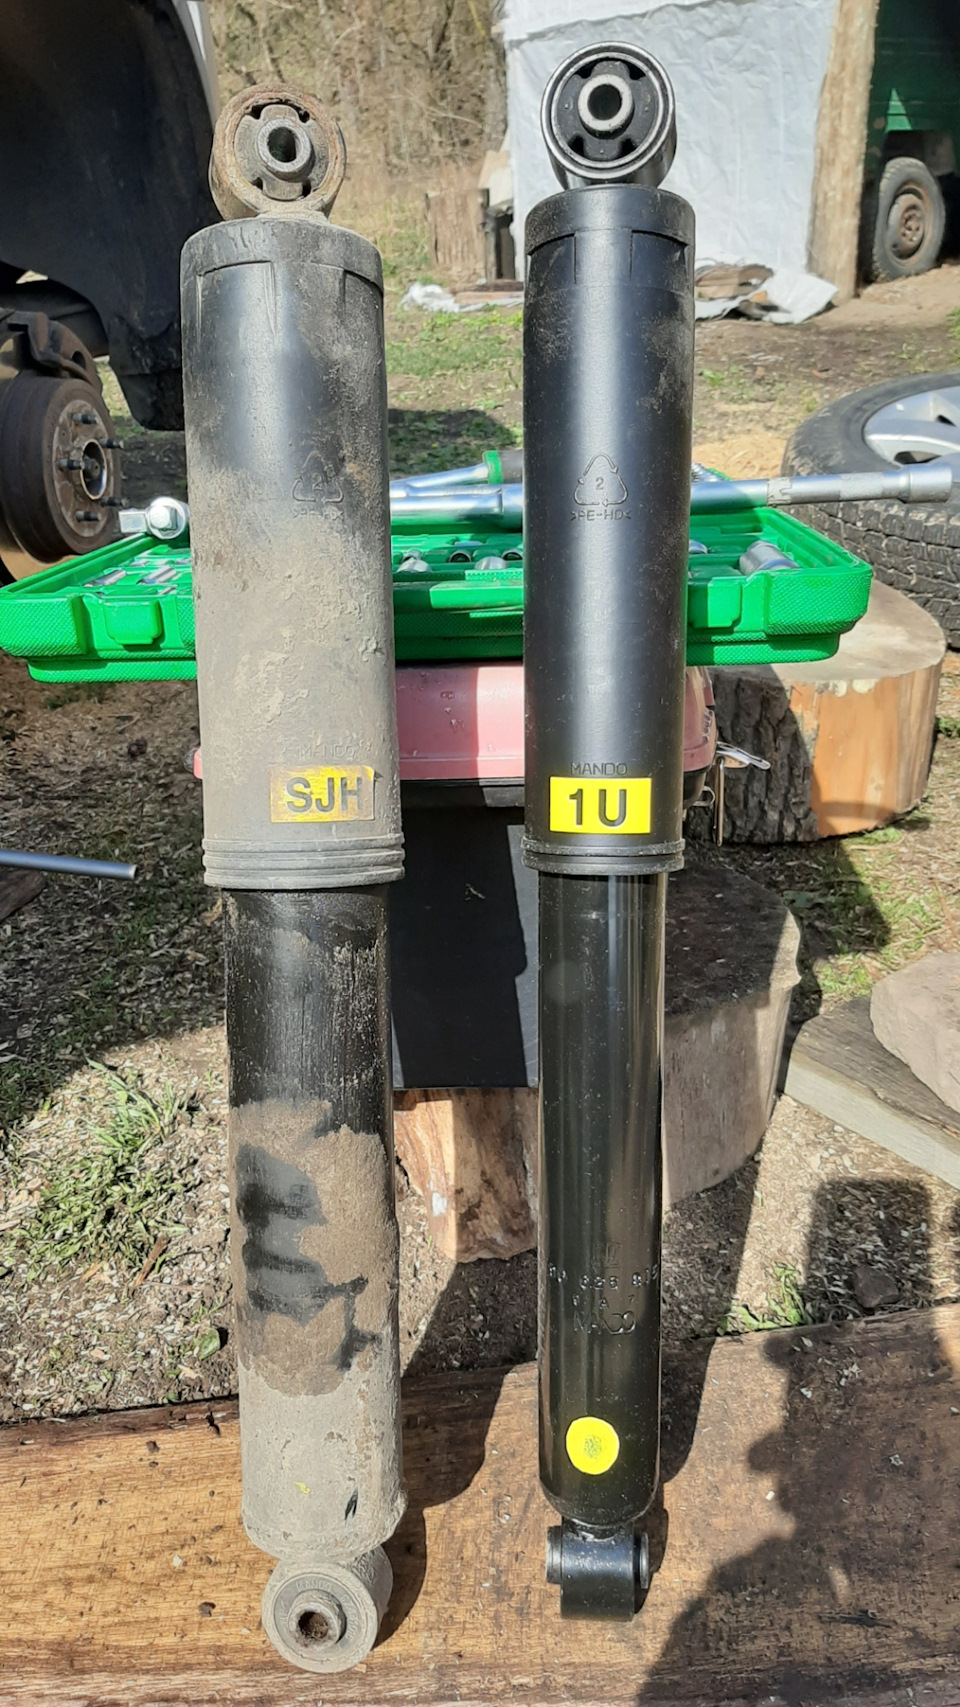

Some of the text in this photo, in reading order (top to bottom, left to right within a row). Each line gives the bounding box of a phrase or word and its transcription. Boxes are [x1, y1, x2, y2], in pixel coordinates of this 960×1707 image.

[595, 477, 605, 490] 2
[570, 762, 628, 776] MANDO
[286, 776, 362, 813] SJH
